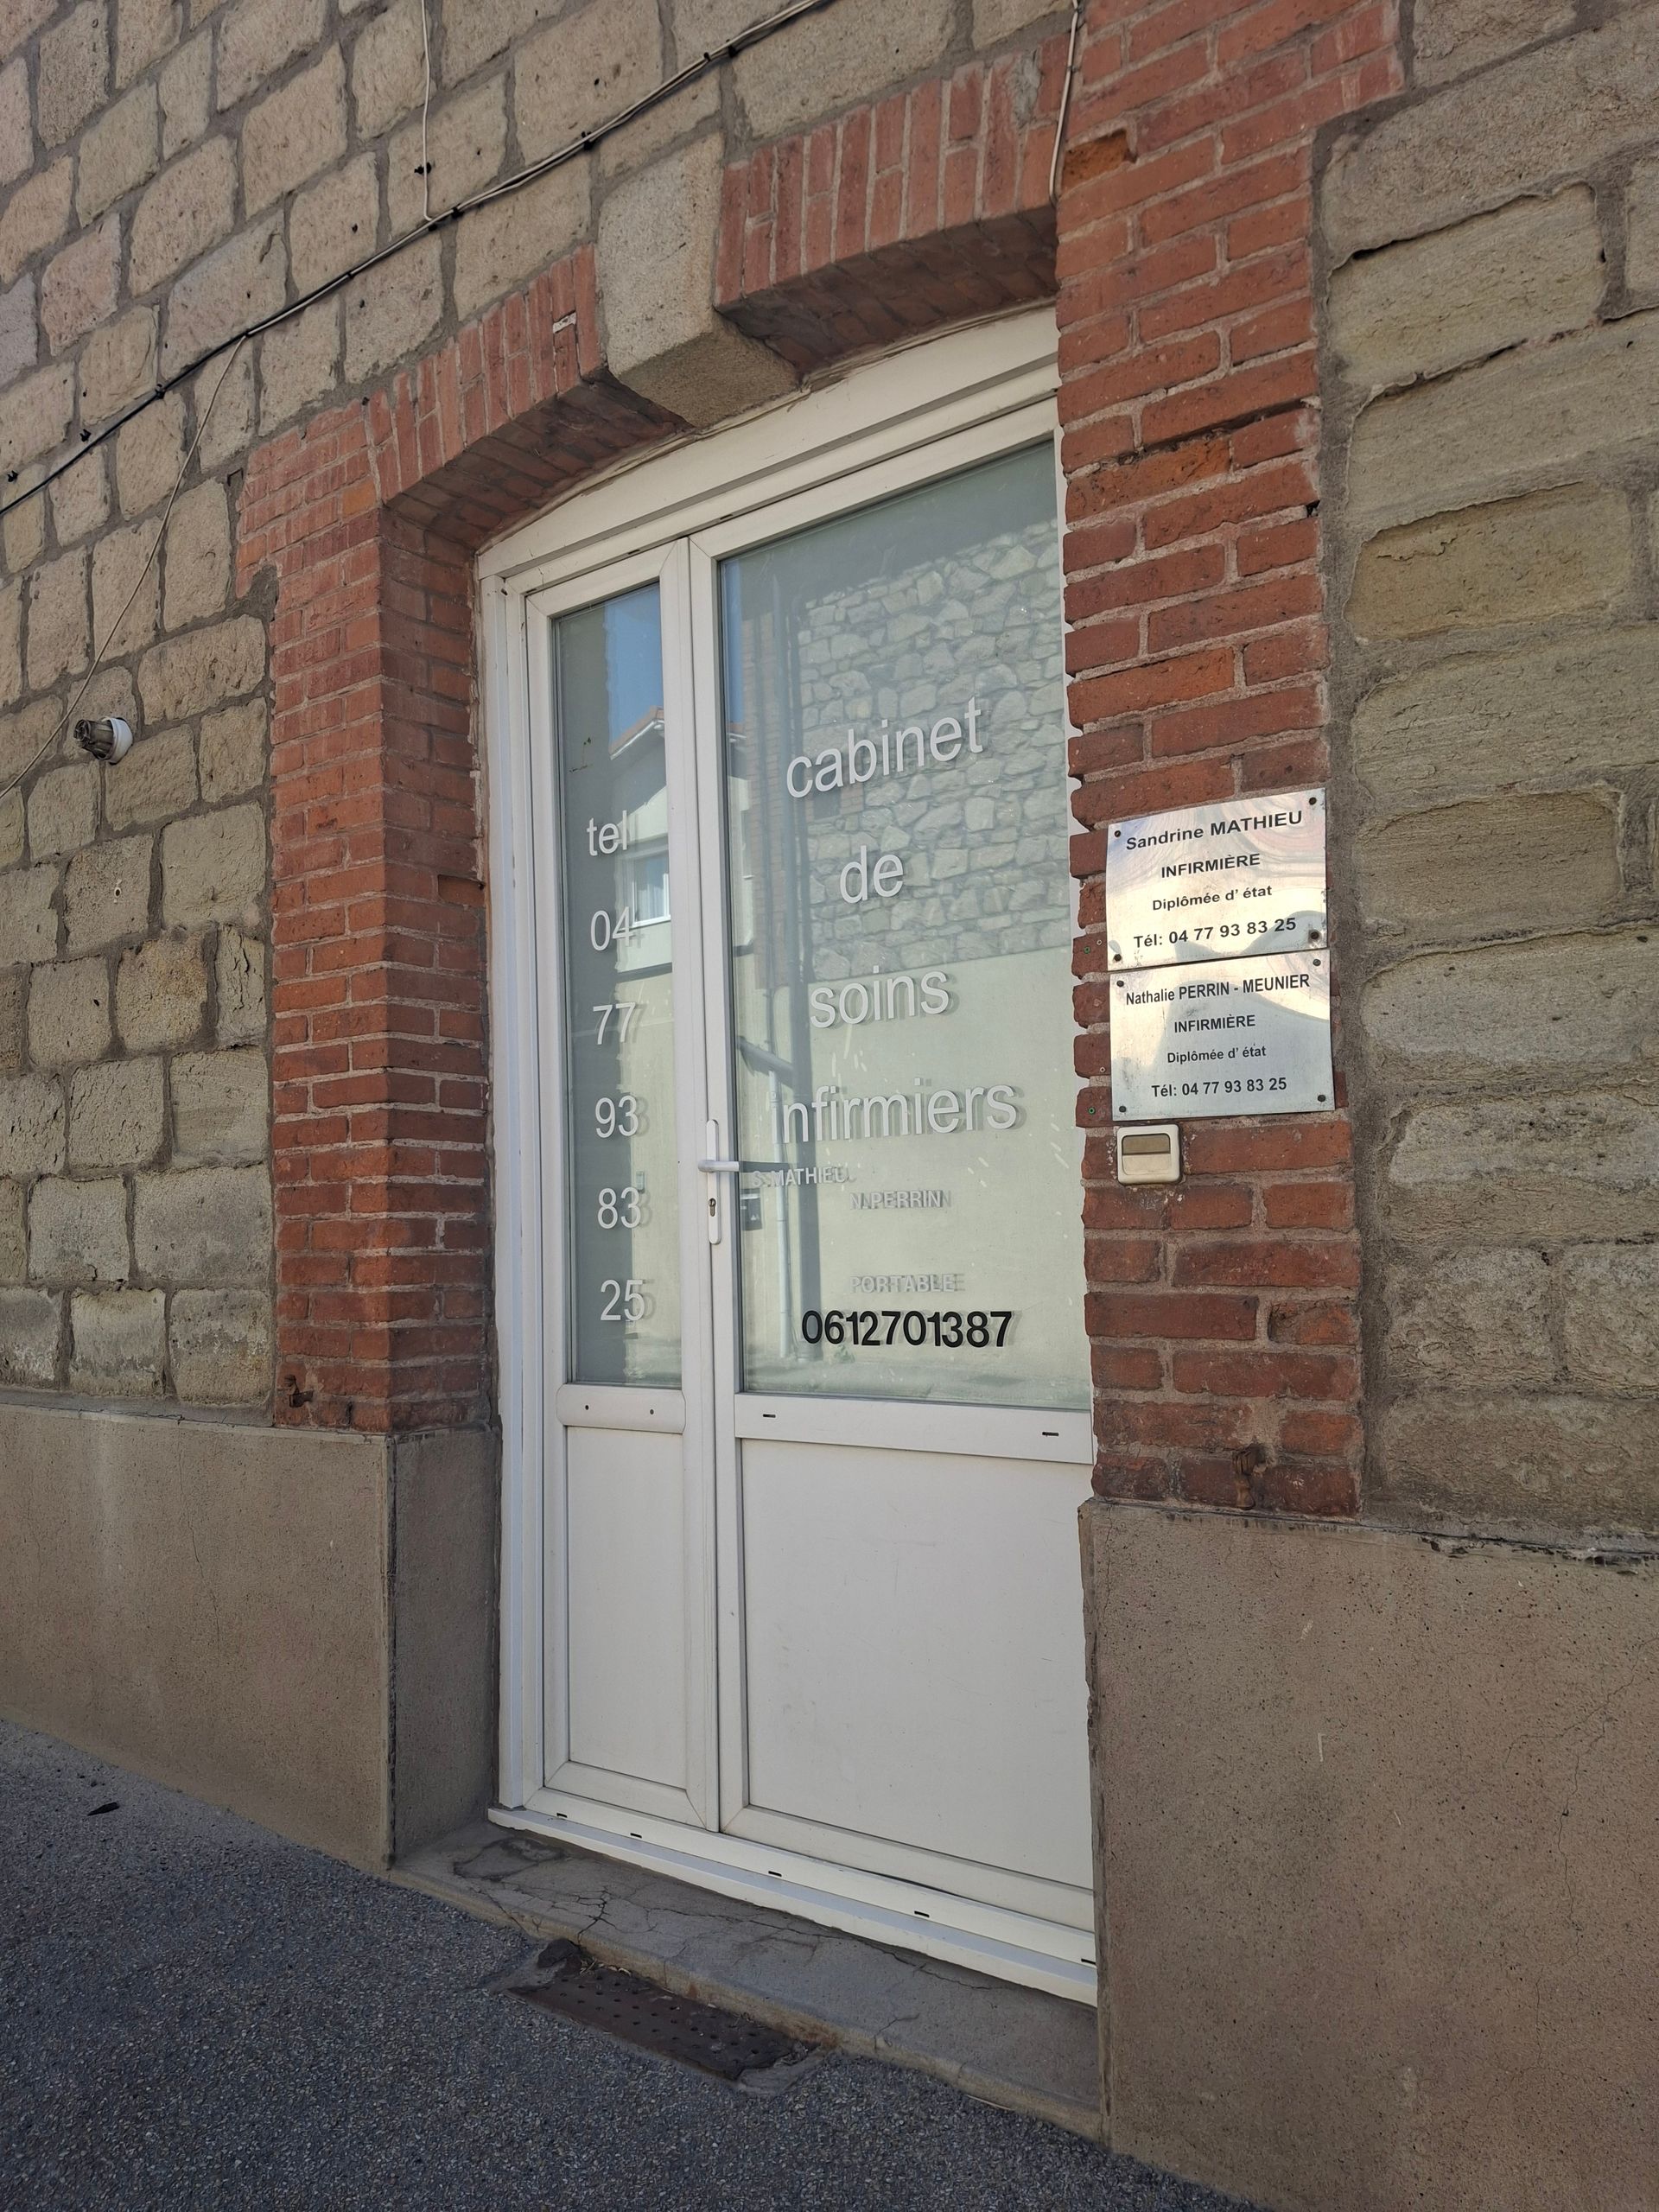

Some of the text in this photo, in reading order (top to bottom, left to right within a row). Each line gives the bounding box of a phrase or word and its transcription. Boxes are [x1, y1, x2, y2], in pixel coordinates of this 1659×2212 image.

[786, 696, 982, 798] cabinet
[587, 810, 627, 856] tel
[1126, 810, 1302, 850] Sandrine MATHIEU
[839, 845, 904, 904] de
[1161, 853, 1261, 878] INFIRMIÈRE
[1153, 893, 1220, 911] Diplômée
[1243, 885, 1272, 899] état
[591, 906, 635, 950] 04
[1134, 917, 1296, 948] Tél: 04 77 93 83 25
[810, 965, 950, 1028] soins
[1126, 988, 1174, 1005] Nathalie
[1179, 982, 1229, 1000] PERRIN
[1243, 974, 1310, 993] MEUNIER
[593, 1002, 636, 1045] 77
[1174, 1014, 1255, 1033] INFIRMIÈRE
[1167, 1048, 1224, 1065] Diplômée
[1243, 1046, 1267, 1058] état
[1151, 1077, 1287, 1097] Tél: 04 77 93 83 25
[594, 1095, 639, 1138] 93
[597, 1186, 641, 1229] 83
[600, 1280, 645, 1321] 25
[849, 1274, 955, 1294] PORTABLE
[802, 1310, 1013, 1348] 0612701387
